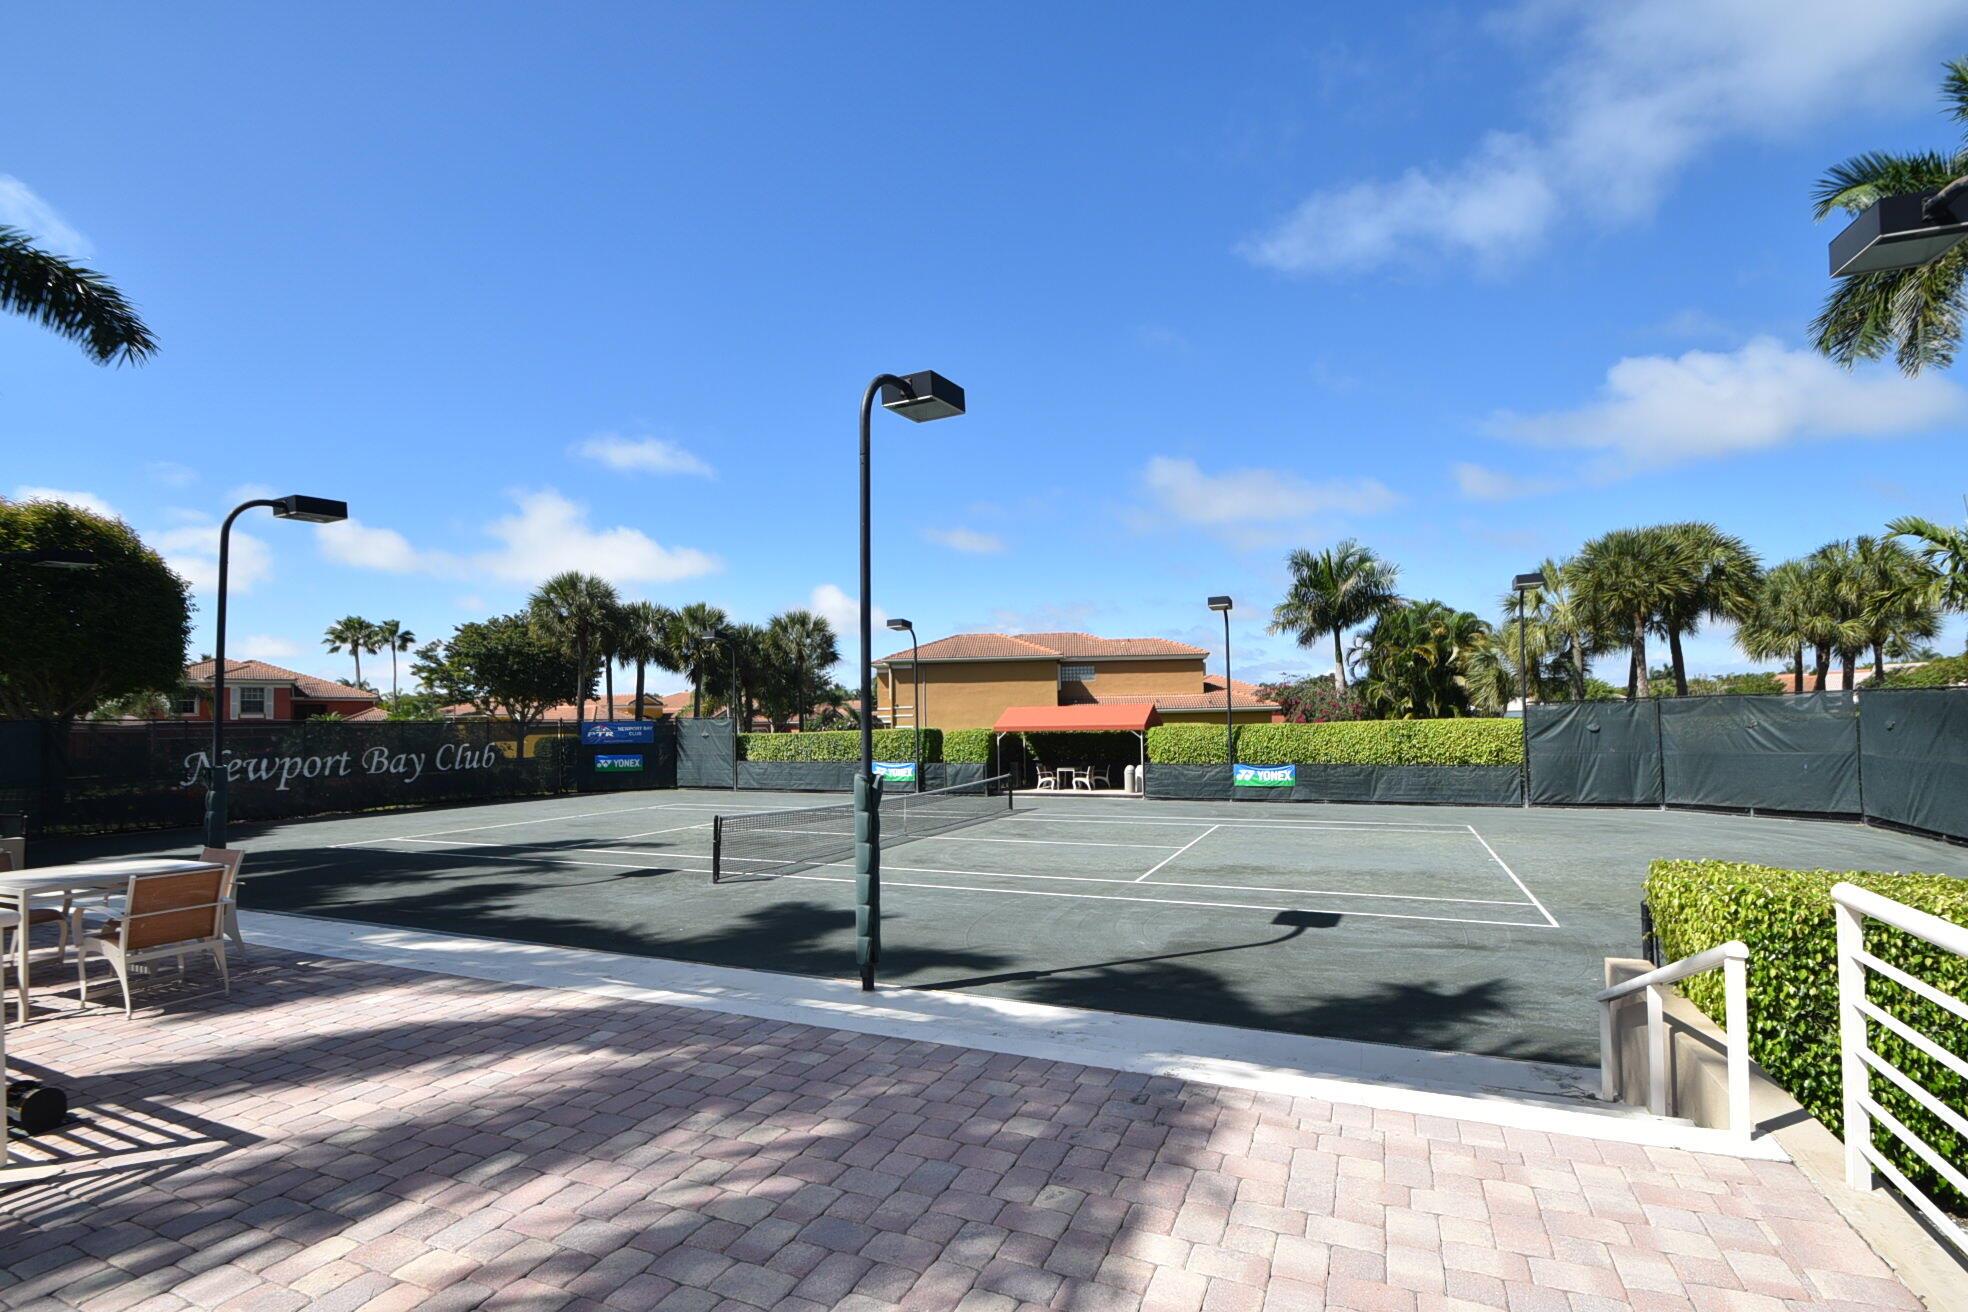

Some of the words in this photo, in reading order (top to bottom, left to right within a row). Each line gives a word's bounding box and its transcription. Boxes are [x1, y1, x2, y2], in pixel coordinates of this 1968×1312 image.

[361, 746, 425, 782] Bay
[436, 742, 496, 771] Club
[614, 759, 640, 767] YONEX
[888, 767, 912, 777] YONEX
[1257, 770, 1292, 781] YONEX
